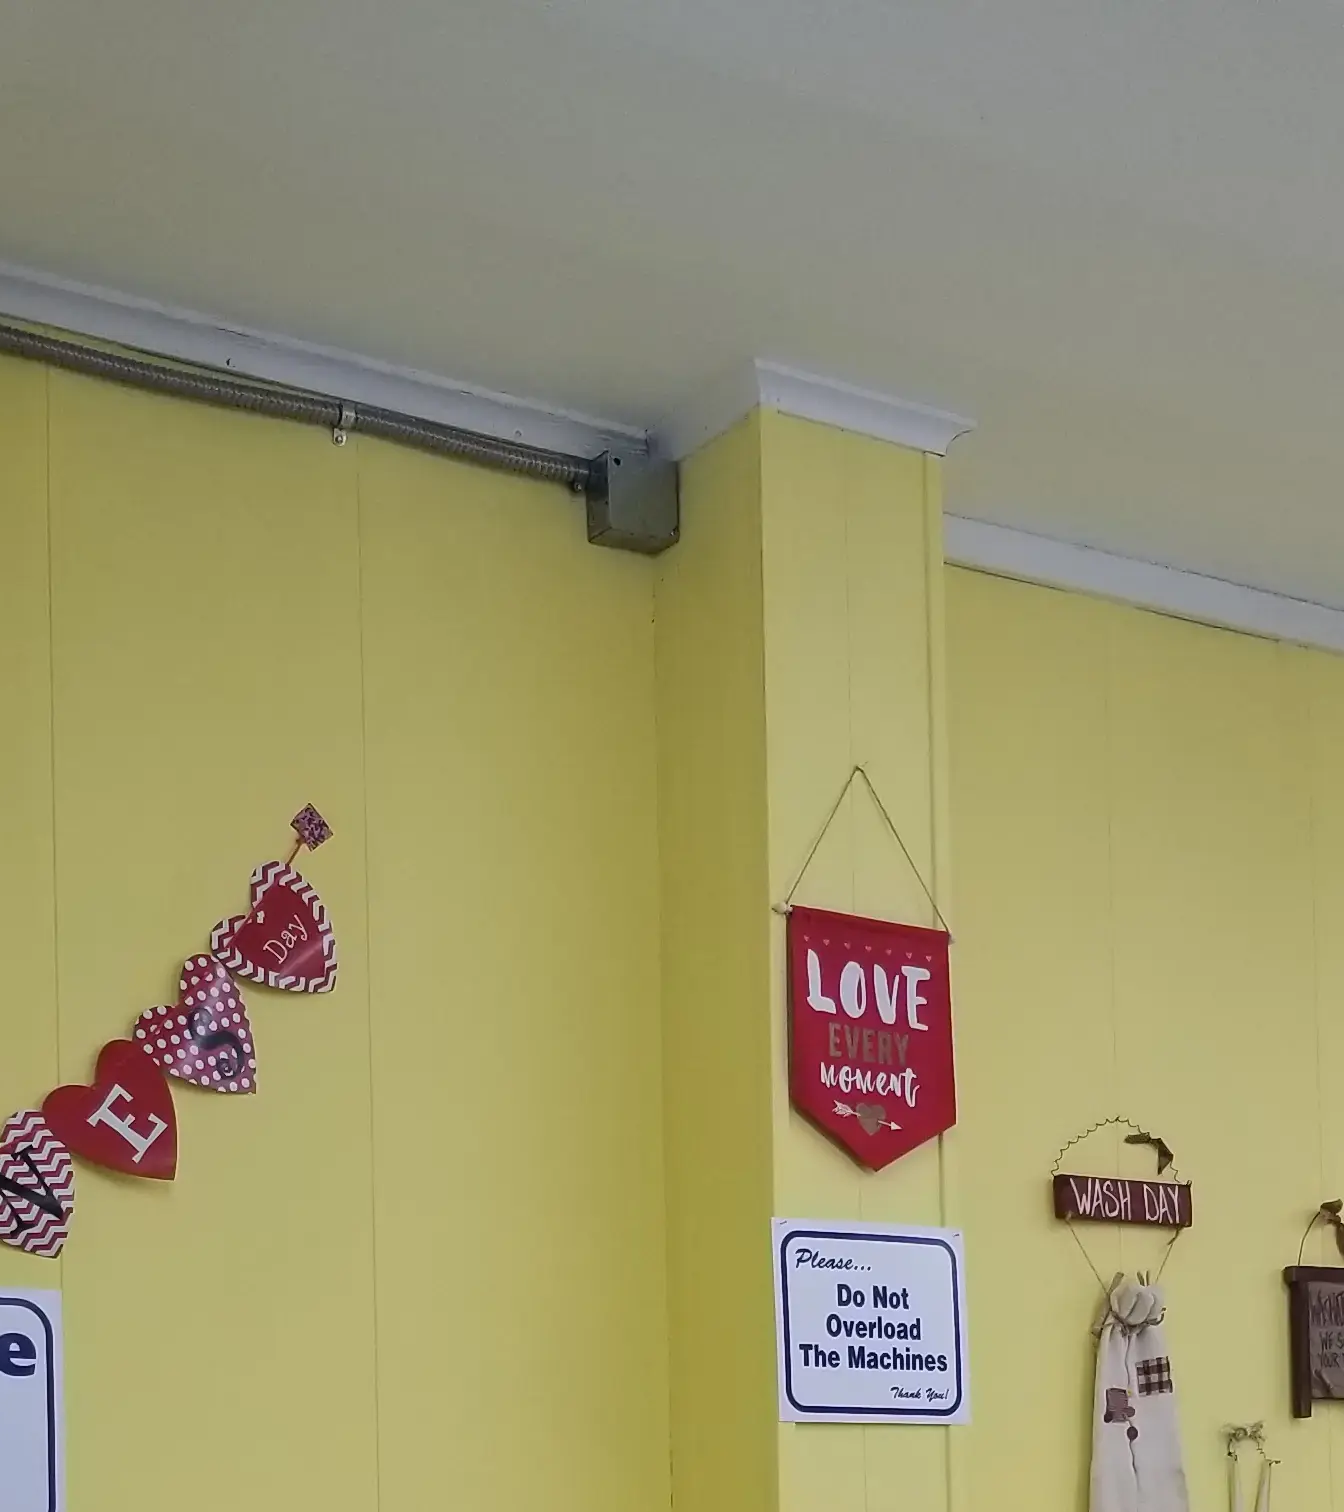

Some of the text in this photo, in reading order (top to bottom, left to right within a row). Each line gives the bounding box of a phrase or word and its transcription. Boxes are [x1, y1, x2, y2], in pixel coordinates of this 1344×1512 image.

[263, 913, 309, 965] Day
[806, 948, 931, 1031] LOVE
[828, 1022, 910, 1066] EVERY
[1069, 1177, 1182, 1225] WASH DAY
[795, 1248, 872, 1272] Please...
[837, 1283, 910, 1310] Do Not
[826, 1313, 921, 1341] Overload
[799, 1343, 948, 1372] The Machines
[890, 1386, 950, 1402] Thank You!
